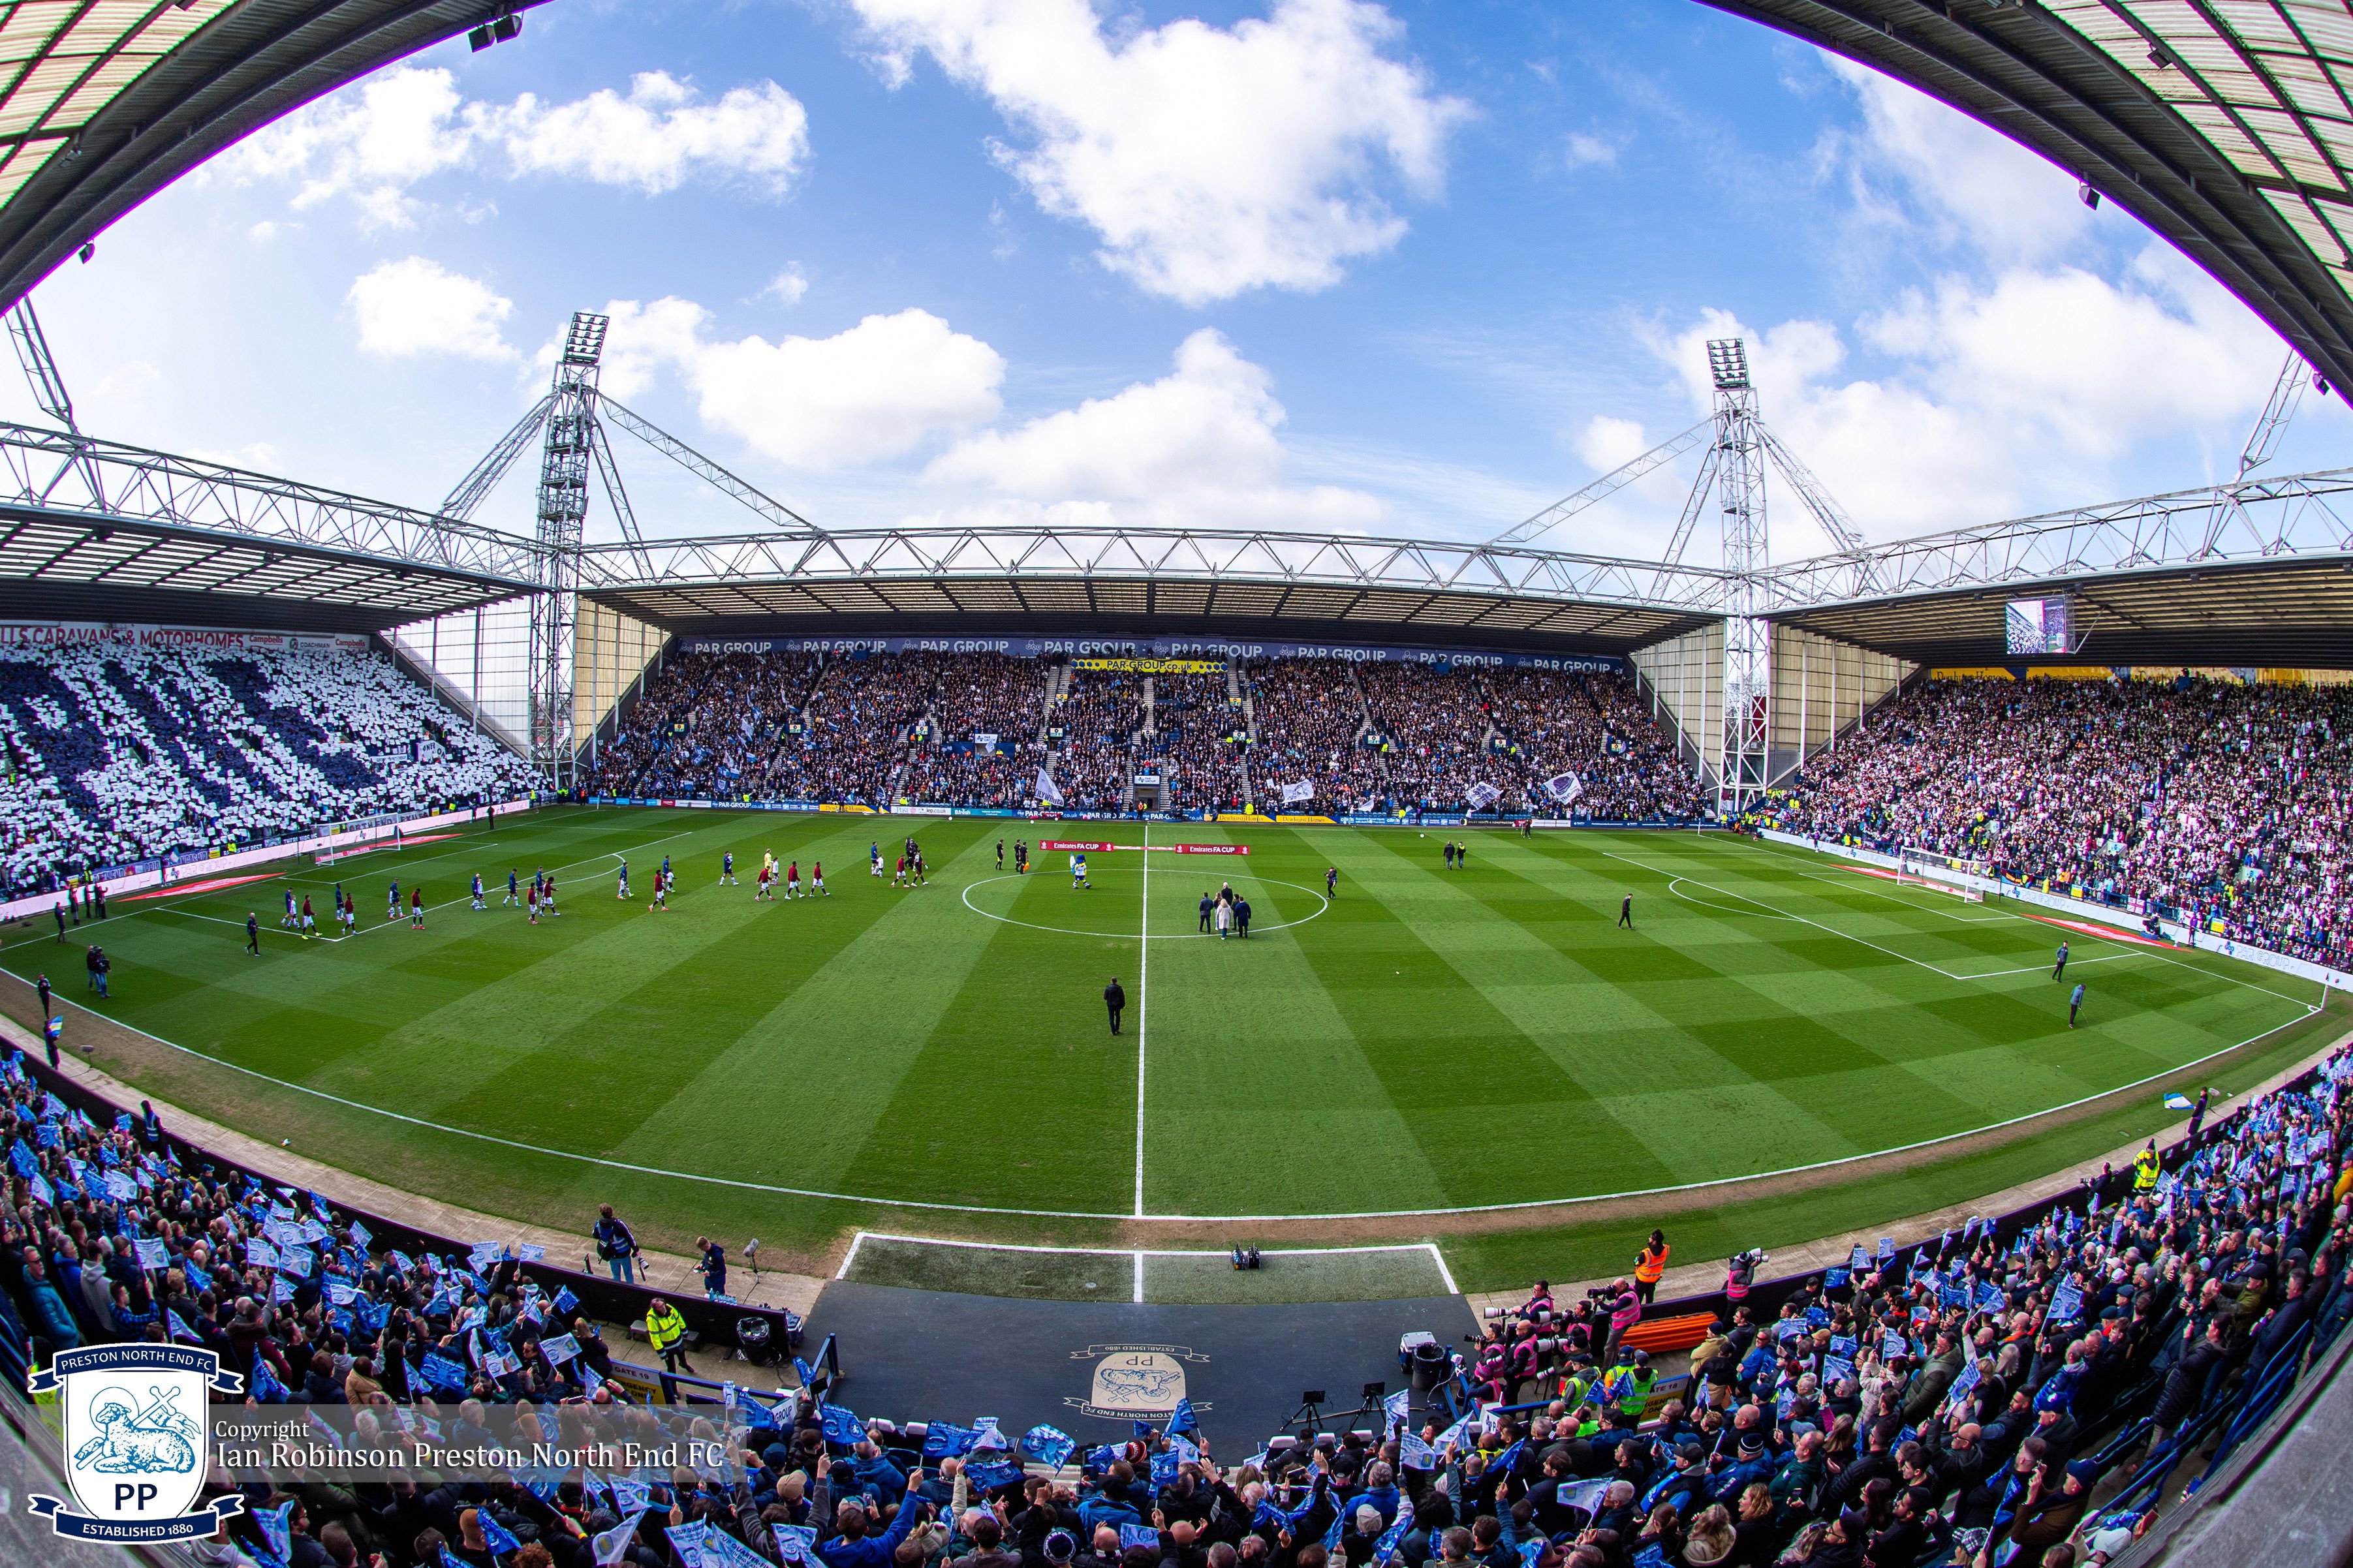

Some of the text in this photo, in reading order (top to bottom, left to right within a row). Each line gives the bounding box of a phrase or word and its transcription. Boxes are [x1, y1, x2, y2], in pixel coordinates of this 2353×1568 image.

[33, 627, 120, 646] CARAVANS
[140, 630, 244, 648] MOTORHOMES
[249, 635, 283, 645] Campbells
[335, 639, 366, 648] Campbells
[695, 642, 771, 653] PAR GROUP
[803, 641, 886, 653] PAR GROUP
[920, 641, 1009, 653] PAR GROUP
[1044, 641, 1136, 654] PAR GROUP
[1206, 644, 1263, 658] GROUP
[1298, 647, 1386, 662] PAR GROUP
[1420, 653, 1503, 666] PAR GROUP
[1107, 660, 1192, 672] PAR-GROUP.co.uk
[1534, 659, 1610, 673] PAR GROUP
[2236, 944, 2290, 968] PAR GROUP
[1126, 1355, 1153, 1366] PP
[614, 1366, 637, 1377] GATE
[775, 1405, 792, 1423] GROUP
